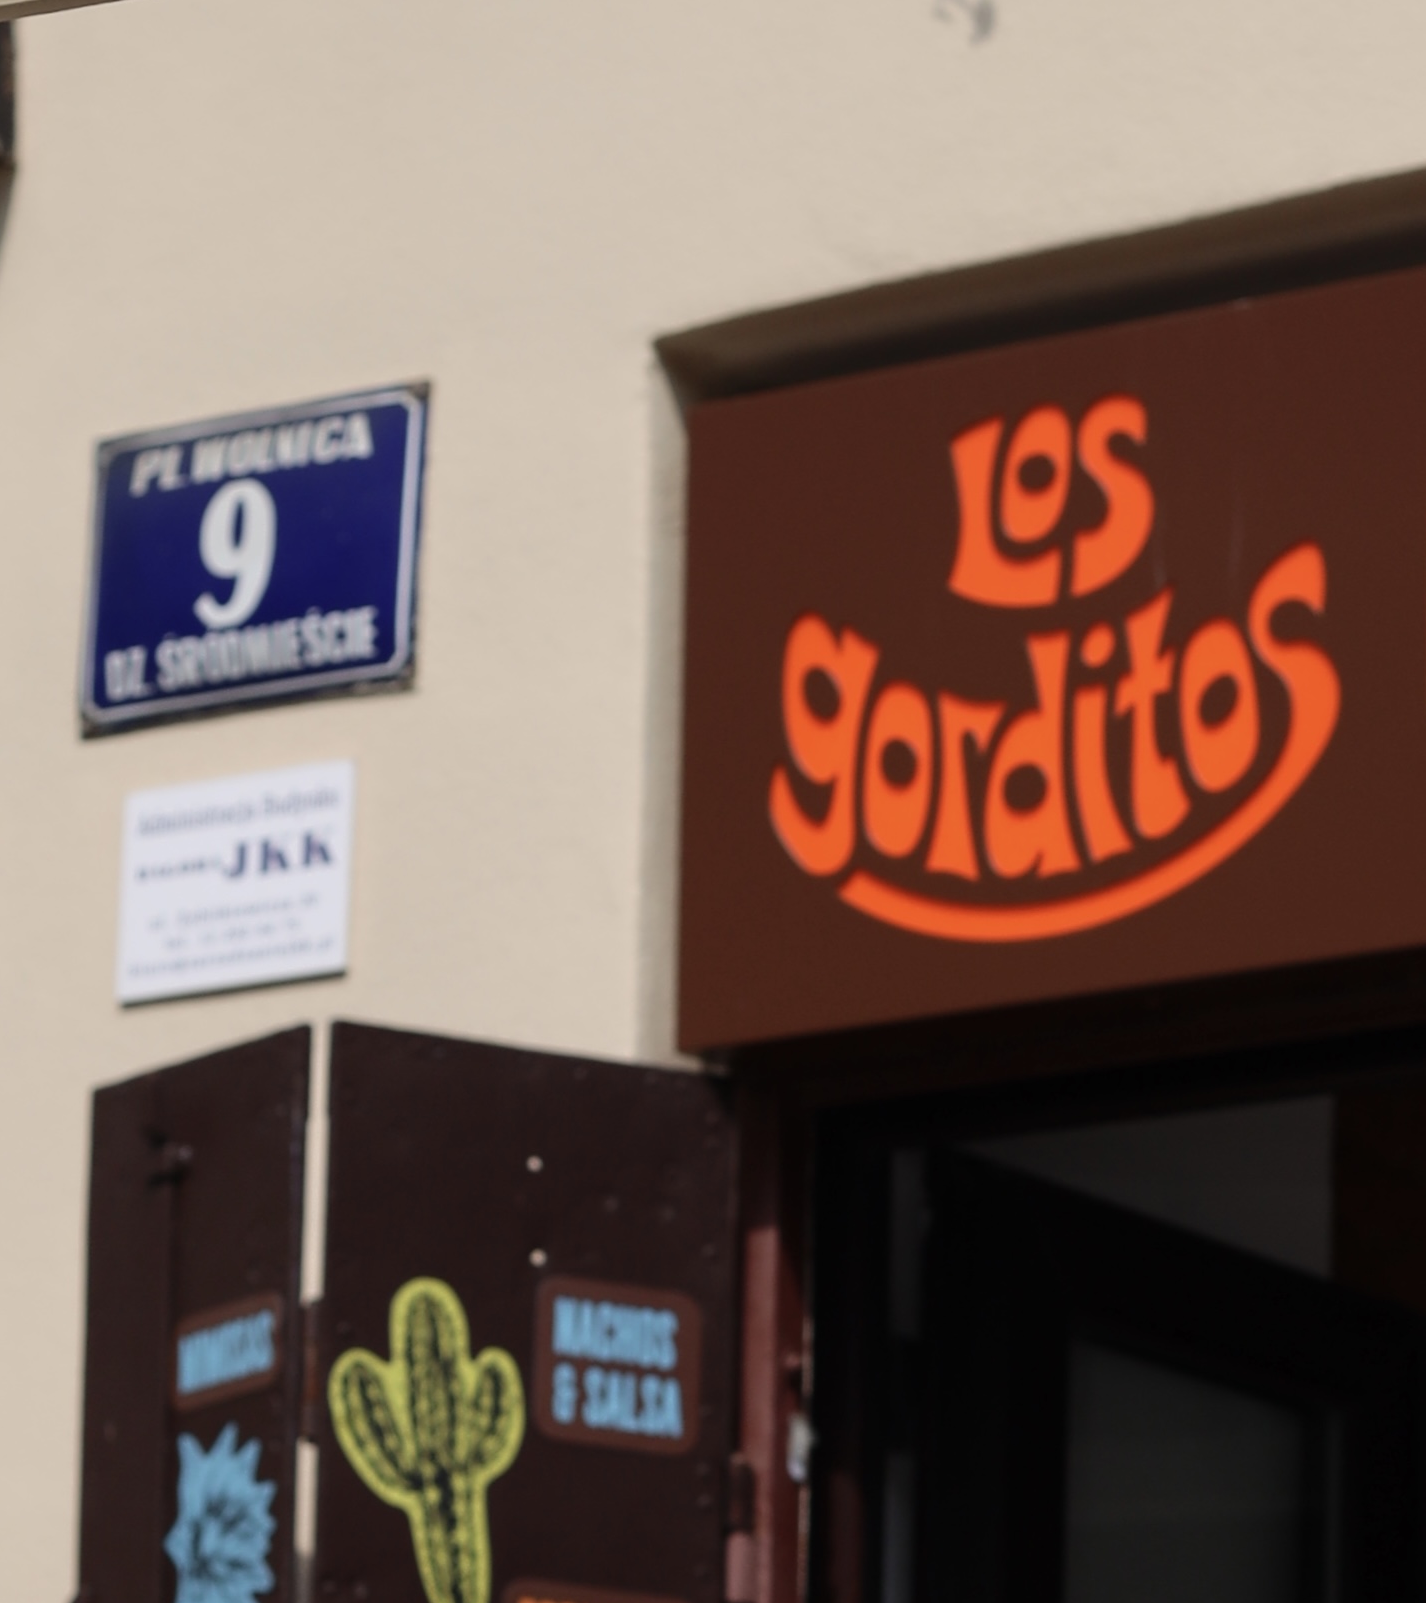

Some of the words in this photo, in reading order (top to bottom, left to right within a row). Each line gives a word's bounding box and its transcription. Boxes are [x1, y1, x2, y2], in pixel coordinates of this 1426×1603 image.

[189, 410, 374, 485] WOLNICA
[192, 476, 278, 629] 9
[769, 541, 1342, 944] gorditos
[224, 827, 335, 881] JKK
[551, 1294, 680, 1372] NACHOS
[581, 1365, 685, 1440] SALSA
